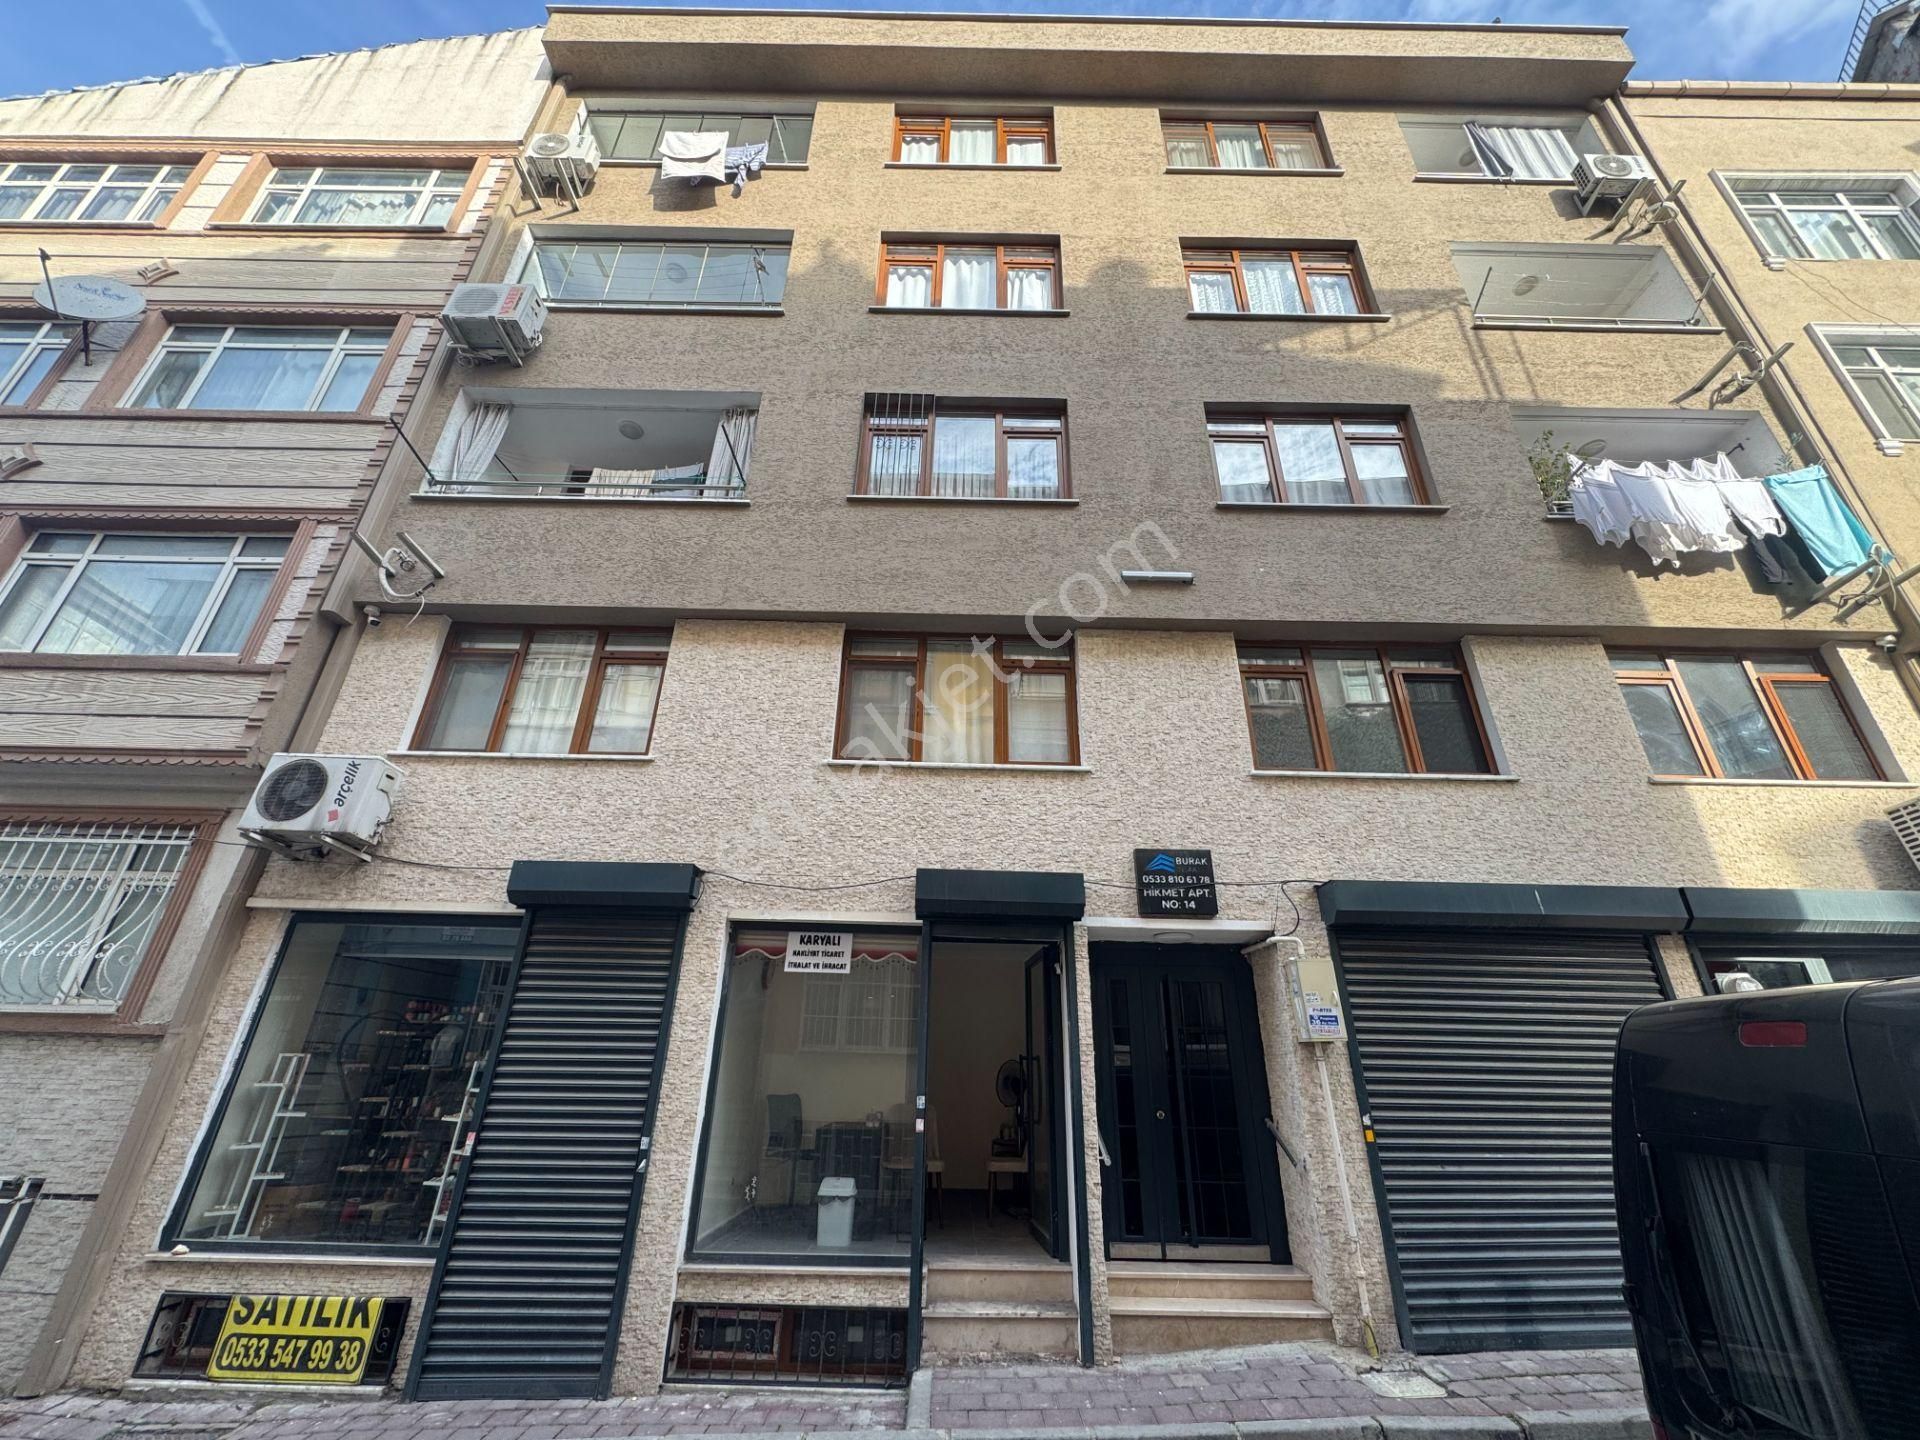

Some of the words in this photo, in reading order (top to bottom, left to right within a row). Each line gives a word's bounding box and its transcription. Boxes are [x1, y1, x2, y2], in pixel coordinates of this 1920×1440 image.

[334, 760, 362, 807] arçelik
[1175, 856, 1208, 866] BURAK
[1142, 875, 1166, 883] 0533
[1168, 875, 1184, 883] 810
[1199, 876, 1210, 884] 78
[1143, 886, 1185, 897] HİKMET
[1161, 900, 1182, 909] NO:
[1184, 900, 1196, 909] 14
[799, 934, 841, 946] KARYALI
[233, 1296, 371, 1329] SATILIK
[221, 1336, 269, 1368] 0533
[269, 1338, 308, 1369] 547
[307, 1339, 334, 1370] 99
[334, 1340, 361, 1371] 38
